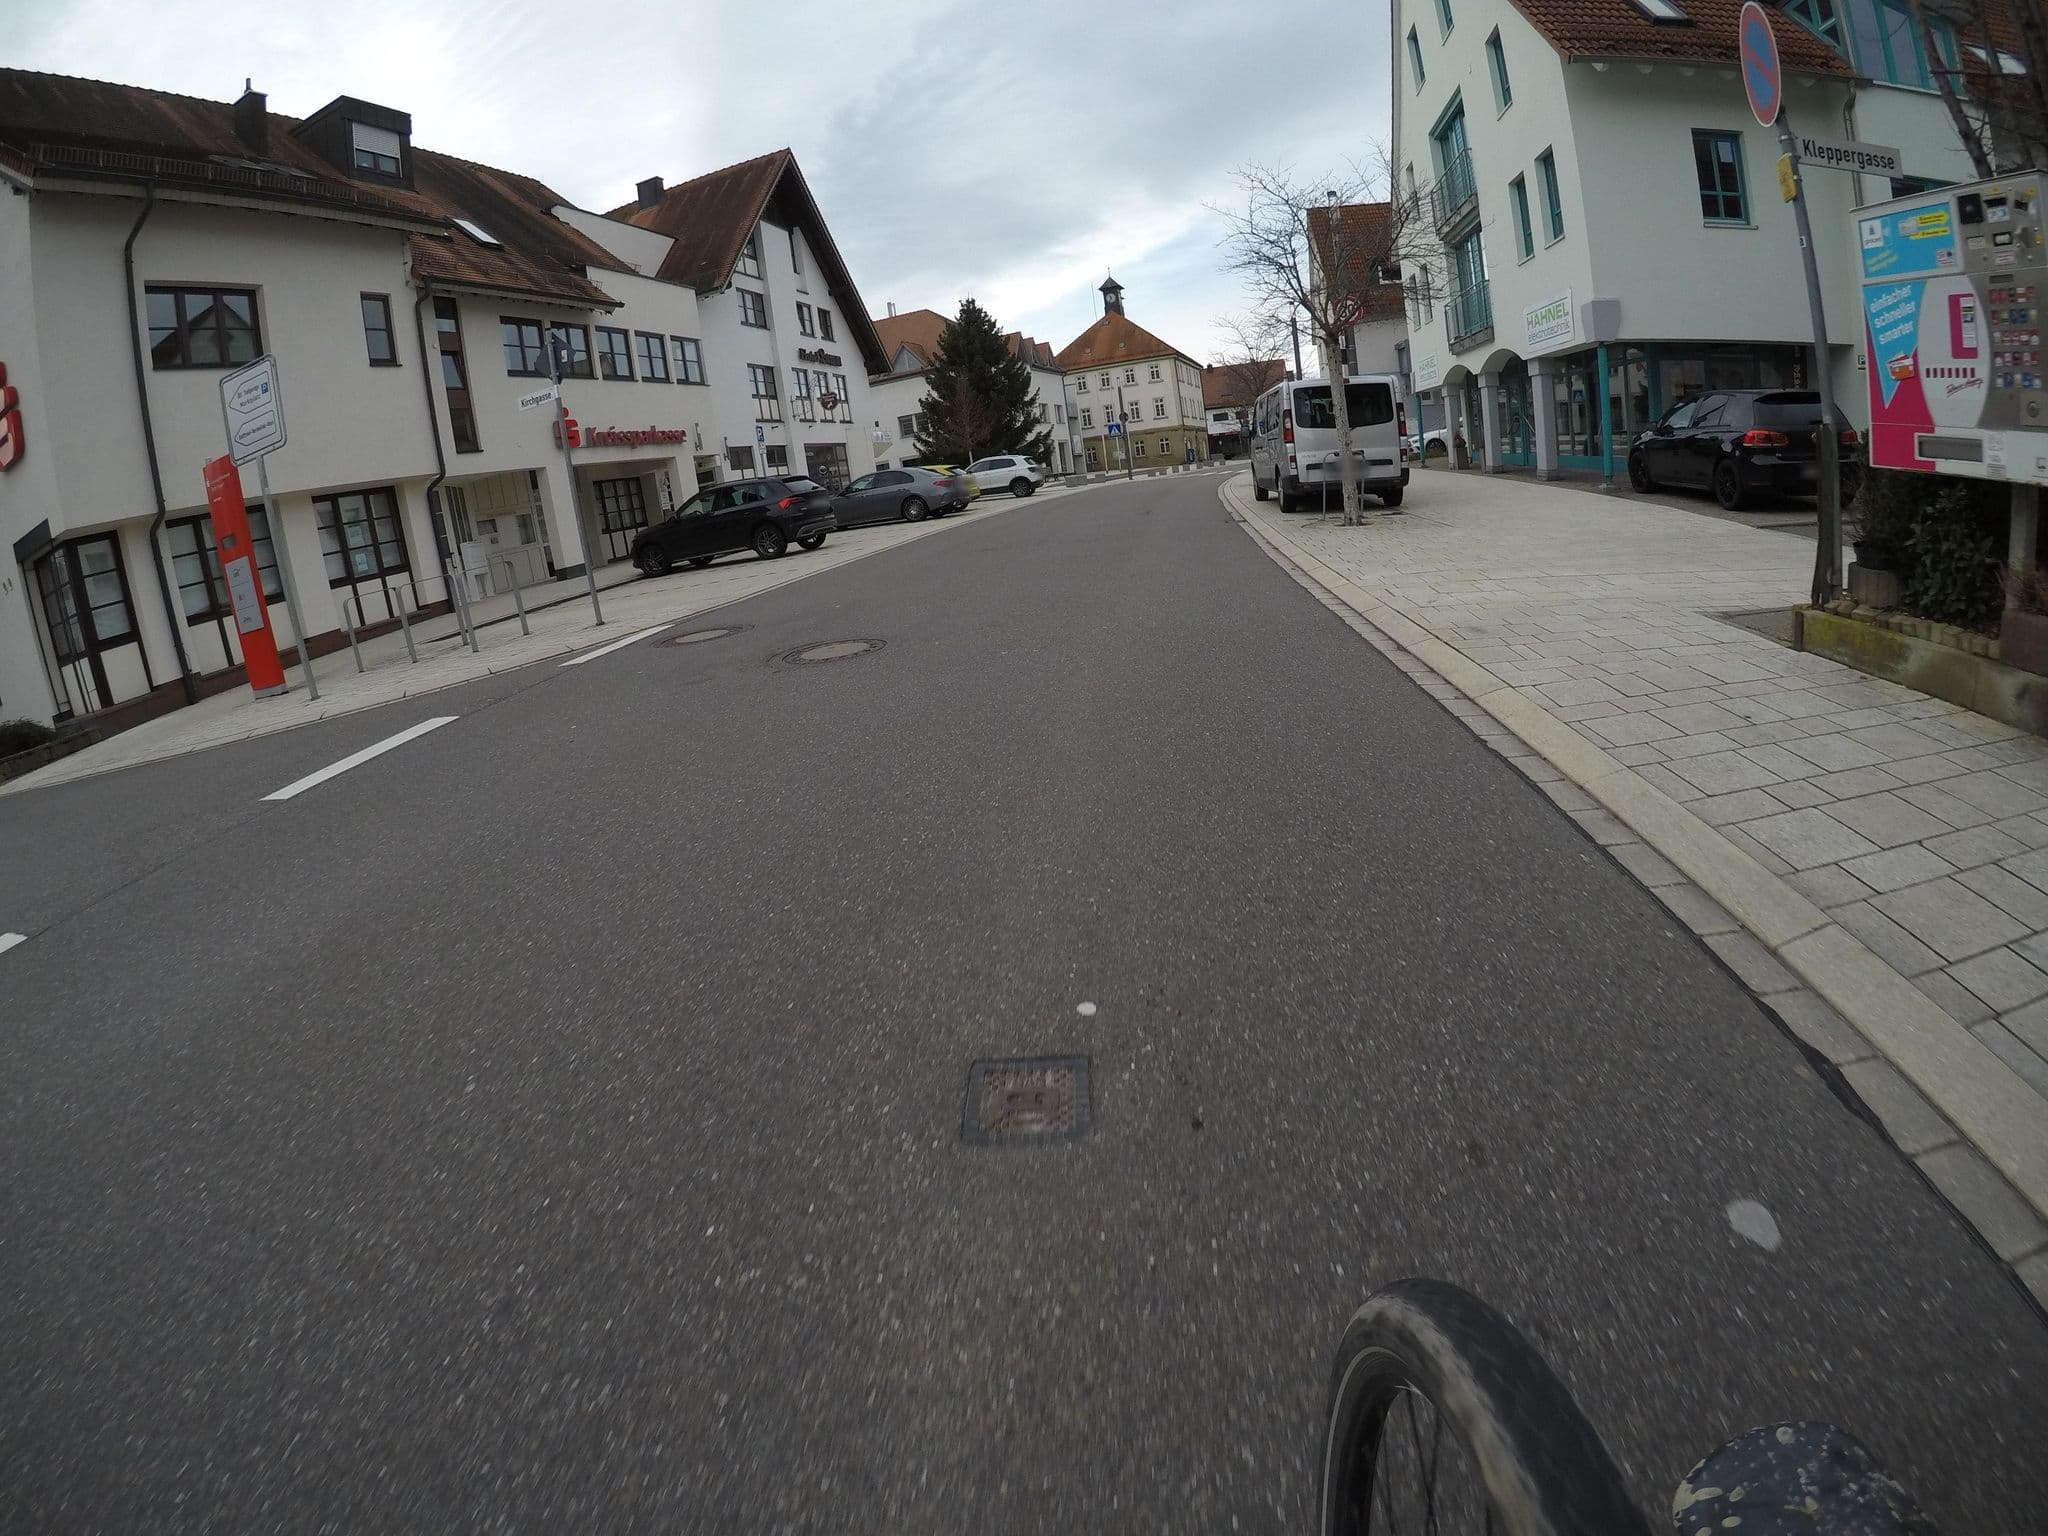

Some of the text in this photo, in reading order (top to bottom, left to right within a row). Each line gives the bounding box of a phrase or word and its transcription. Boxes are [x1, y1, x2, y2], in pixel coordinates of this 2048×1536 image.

[1802, 138, 1895, 170] Kleppergasse
[1870, 284, 1912, 313] einfacher
[1526, 302, 1570, 330] HAHNEL
[1874, 301, 1916, 328] schneller
[1879, 321, 1914, 345] smarter
[520, 390, 552, 409] Kirchgasse
